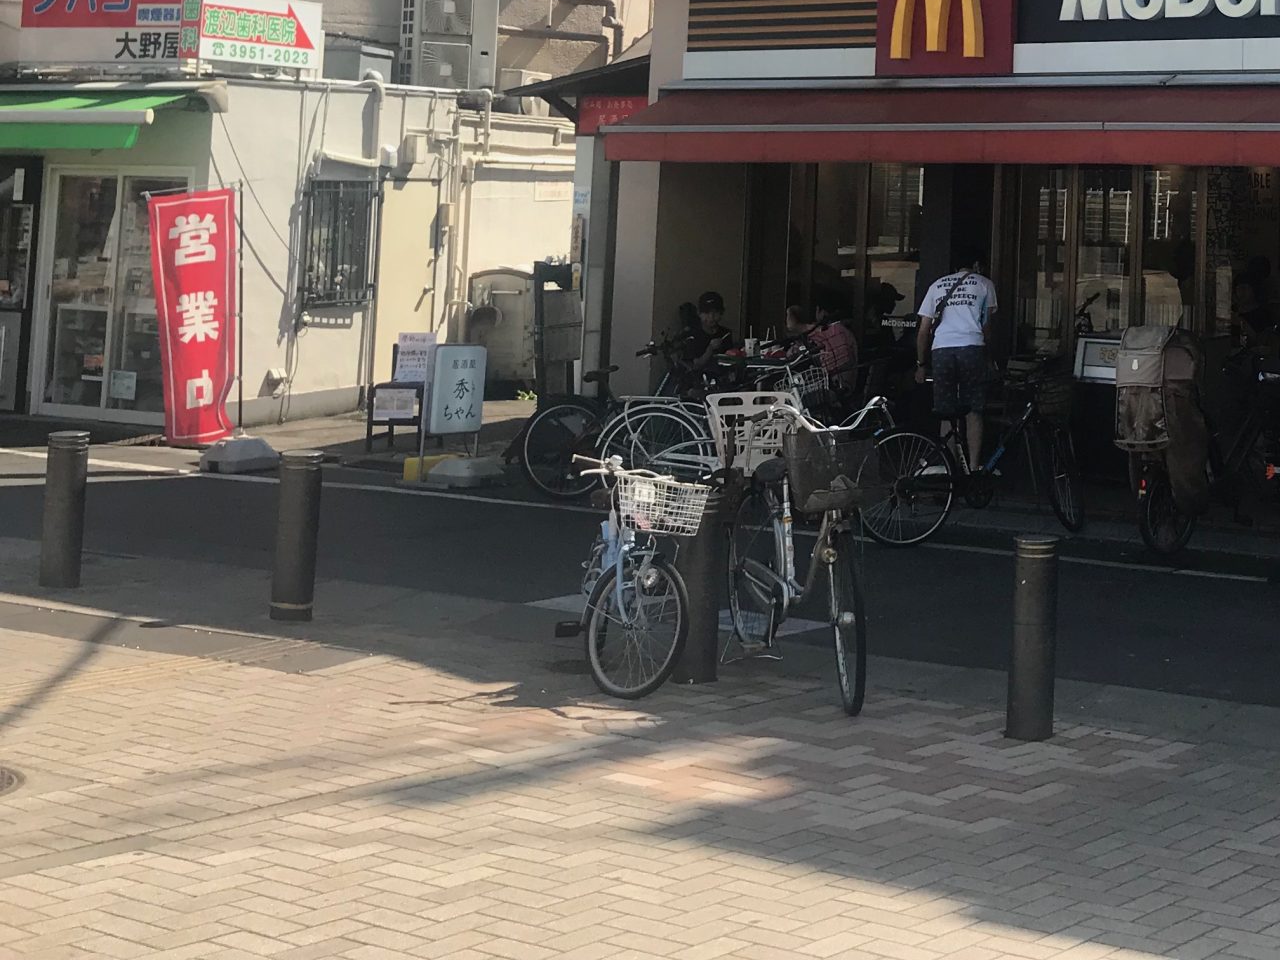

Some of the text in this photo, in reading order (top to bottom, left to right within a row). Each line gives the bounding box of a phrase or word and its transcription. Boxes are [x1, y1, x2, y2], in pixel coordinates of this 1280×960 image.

[203, 6, 297, 46] 渡辺歯科医院
[114, 31, 180, 60] 大野屋
[228, 41, 310, 65] 3951-2023
[453, 378, 470, 400] 秀
[443, 403, 476, 421] ちゃん
